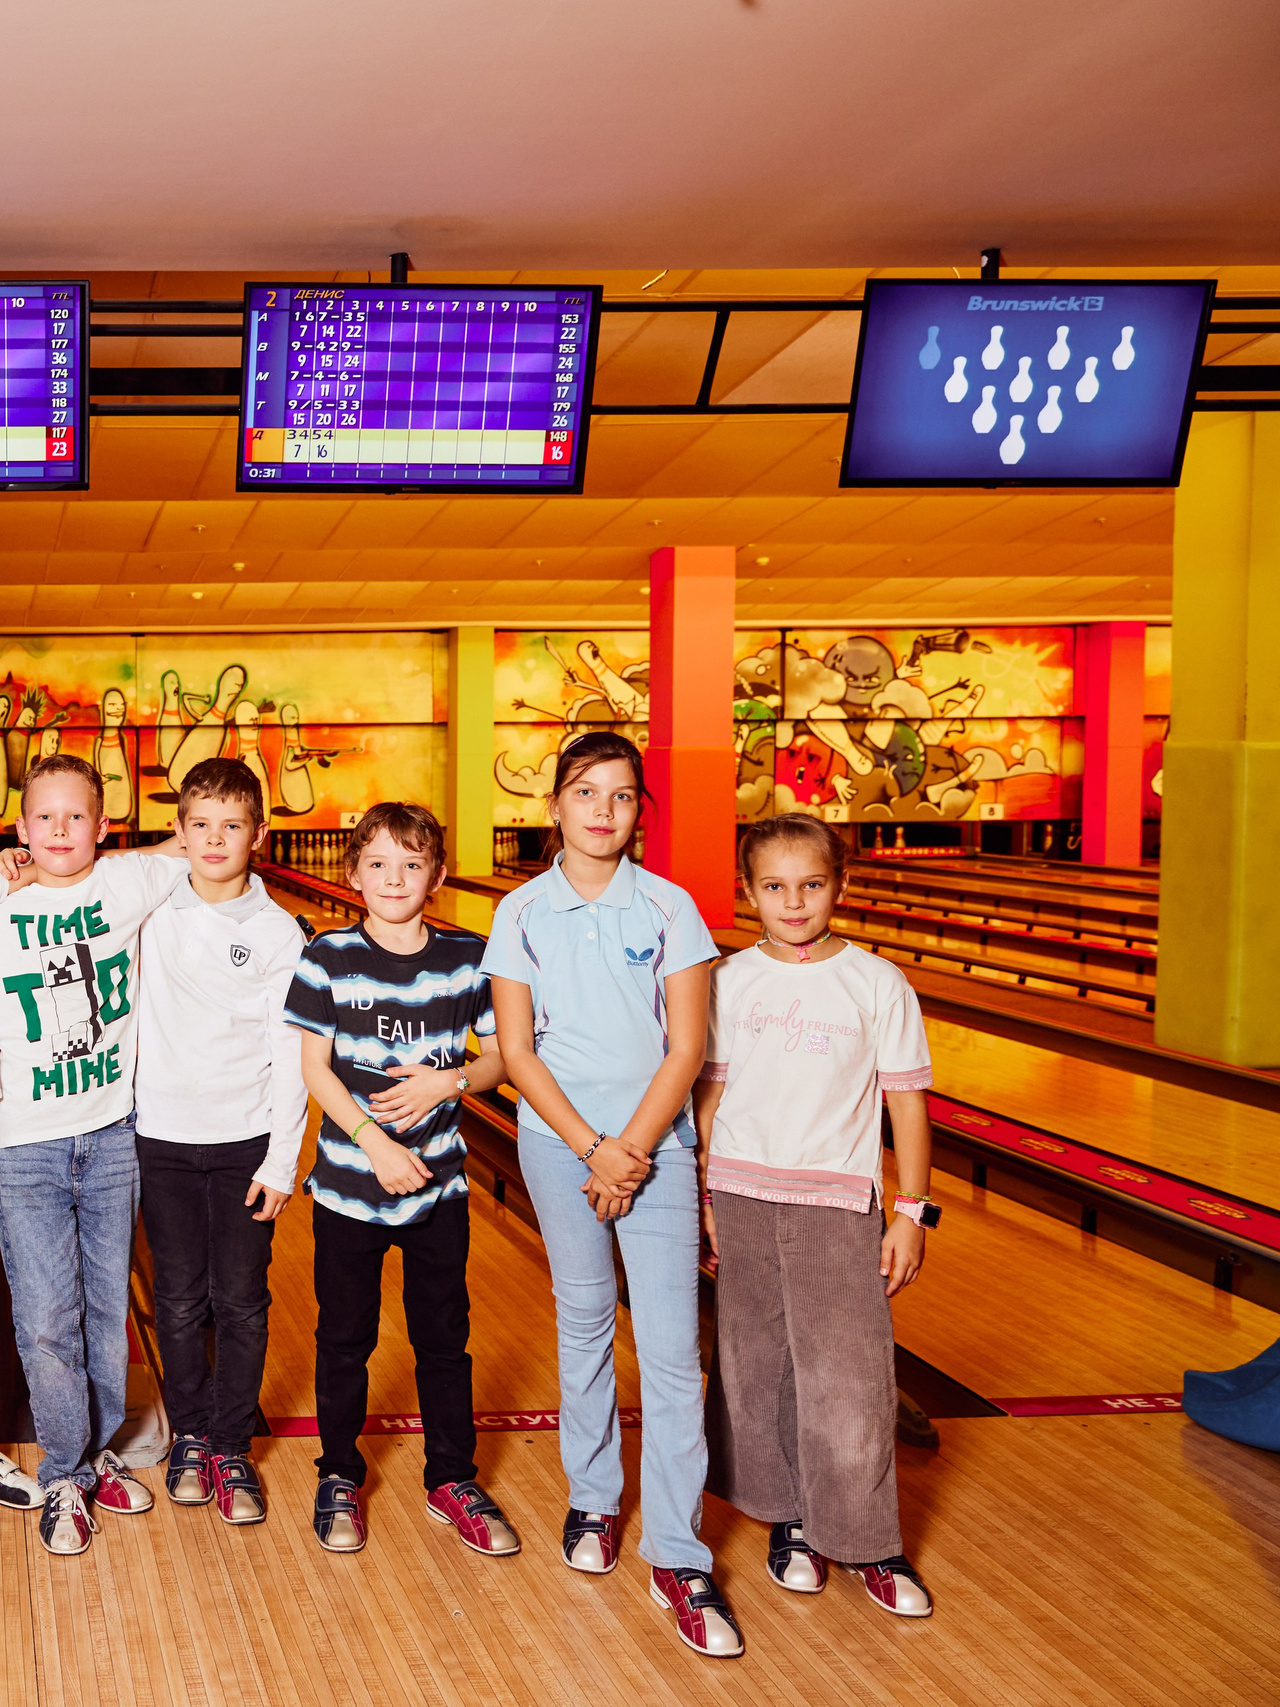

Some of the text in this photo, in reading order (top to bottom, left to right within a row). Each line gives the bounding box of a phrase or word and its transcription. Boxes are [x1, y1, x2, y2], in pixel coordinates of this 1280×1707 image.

[52, 292, 69, 300] TTL
[266, 290, 345, 307] 2 ДЕНИС
[12, 298, 25, 308] 10
[302, 301, 537, 311] 1 2 3 4 5 6 7 8 9 10
[967, 296, 1082, 311] Brunswick
[50, 309, 68, 319] 120
[561, 314, 579, 323] 153
[53, 323, 65, 335] 17
[300, 325, 576, 340] 7 14 22 22
[51, 339, 68, 348] 177
[559, 344, 575, 353] 155
[52, 352, 67, 364] 36
[298, 355, 573, 369] 9 15 24 24
[51, 369, 68, 378] 174
[555, 374, 573, 382] 168
[52, 382, 67, 394] 33
[297, 384, 569, 399] 7 11 17 17
[51, 398, 67, 408] 118
[554, 402, 570, 411] 179
[52, 411, 67, 423] 27
[293, 414, 568, 427] 15 20 26 26
[51, 427, 67, 438] 117
[550, 431, 567, 442] 148
[52, 443, 67, 456] 23
[294, 445, 563, 461] 7 16 16
[249, 469, 276, 478] 0:31
[833, 810, 839, 818] 7
[988, 809, 995, 817] 8
[349, 815, 356, 825] 4
[10, 900, 110, 950] TIME
[2, 949, 130, 1043] TO
[350, 987, 374, 1011] ID
[749, 999, 807, 1052] family
[807, 1020, 859, 1037] FRIENDS
[32, 1044, 122, 1101] MINE
[721, 1182, 758, 1198] YOU'RE
[760, 1191, 804, 1204] WORTH
[806, 1195, 818, 1205] IT
[824, 1197, 869, 1212] YOU'RE
[1102, 1399, 1156, 1409] НЕ
[380, 1418, 424, 1429] НЕ
